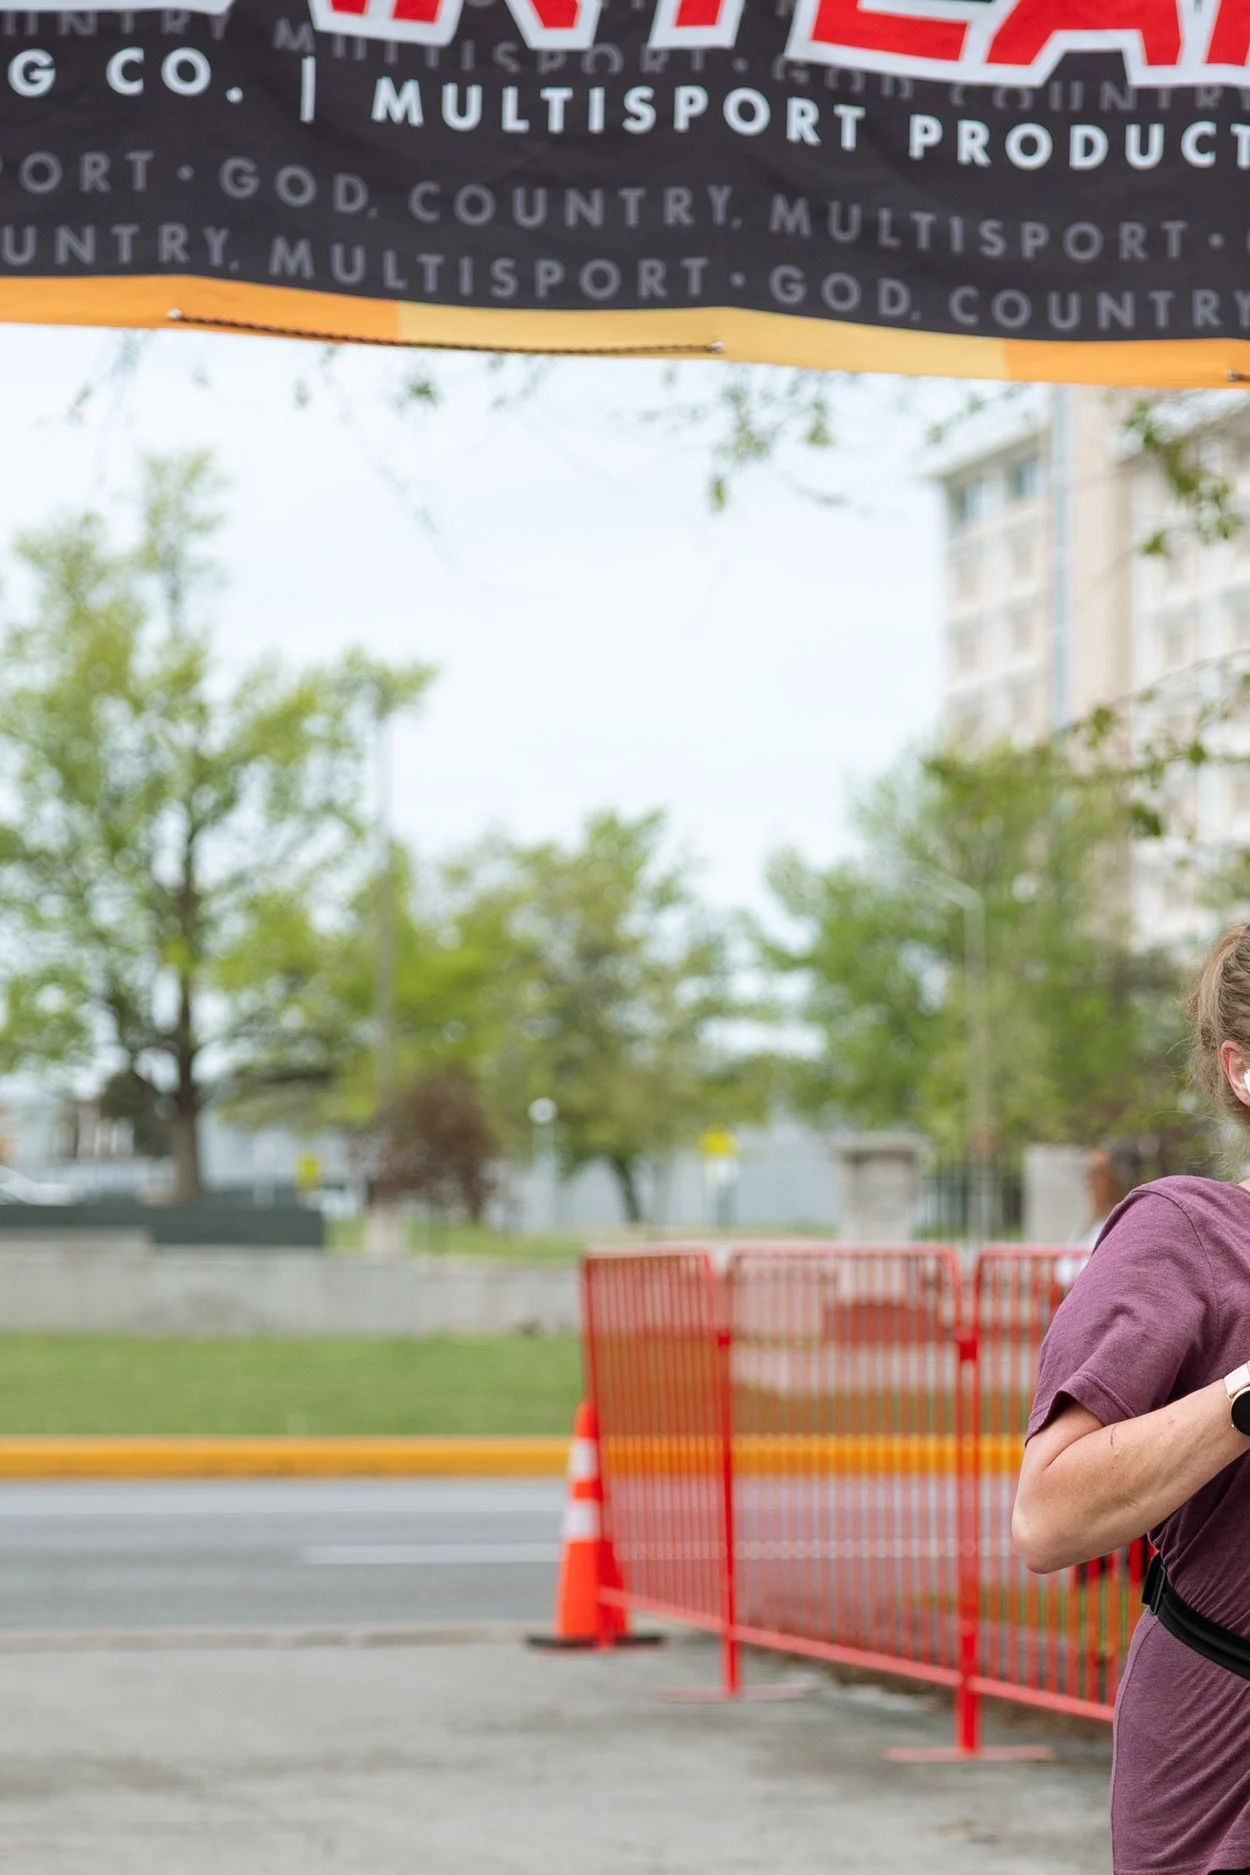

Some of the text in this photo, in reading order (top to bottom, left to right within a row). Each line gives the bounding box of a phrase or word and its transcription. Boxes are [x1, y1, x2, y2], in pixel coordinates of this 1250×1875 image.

[6, 48, 57, 97] G
[105, 46, 244, 104] CO.
[370, 75, 866, 152] MULTISPORT
[0, 149, 154, 194] ORT
[218, 156, 379, 220] GOD,
[408, 180, 743, 231] COUNTRY,
[768, 194, 1190, 263] MULTISPORT
[0, 223, 240, 273] UNTRY,
[268, 235, 709, 300] MULTISPORT
[768, 264, 922, 322] GOD,
